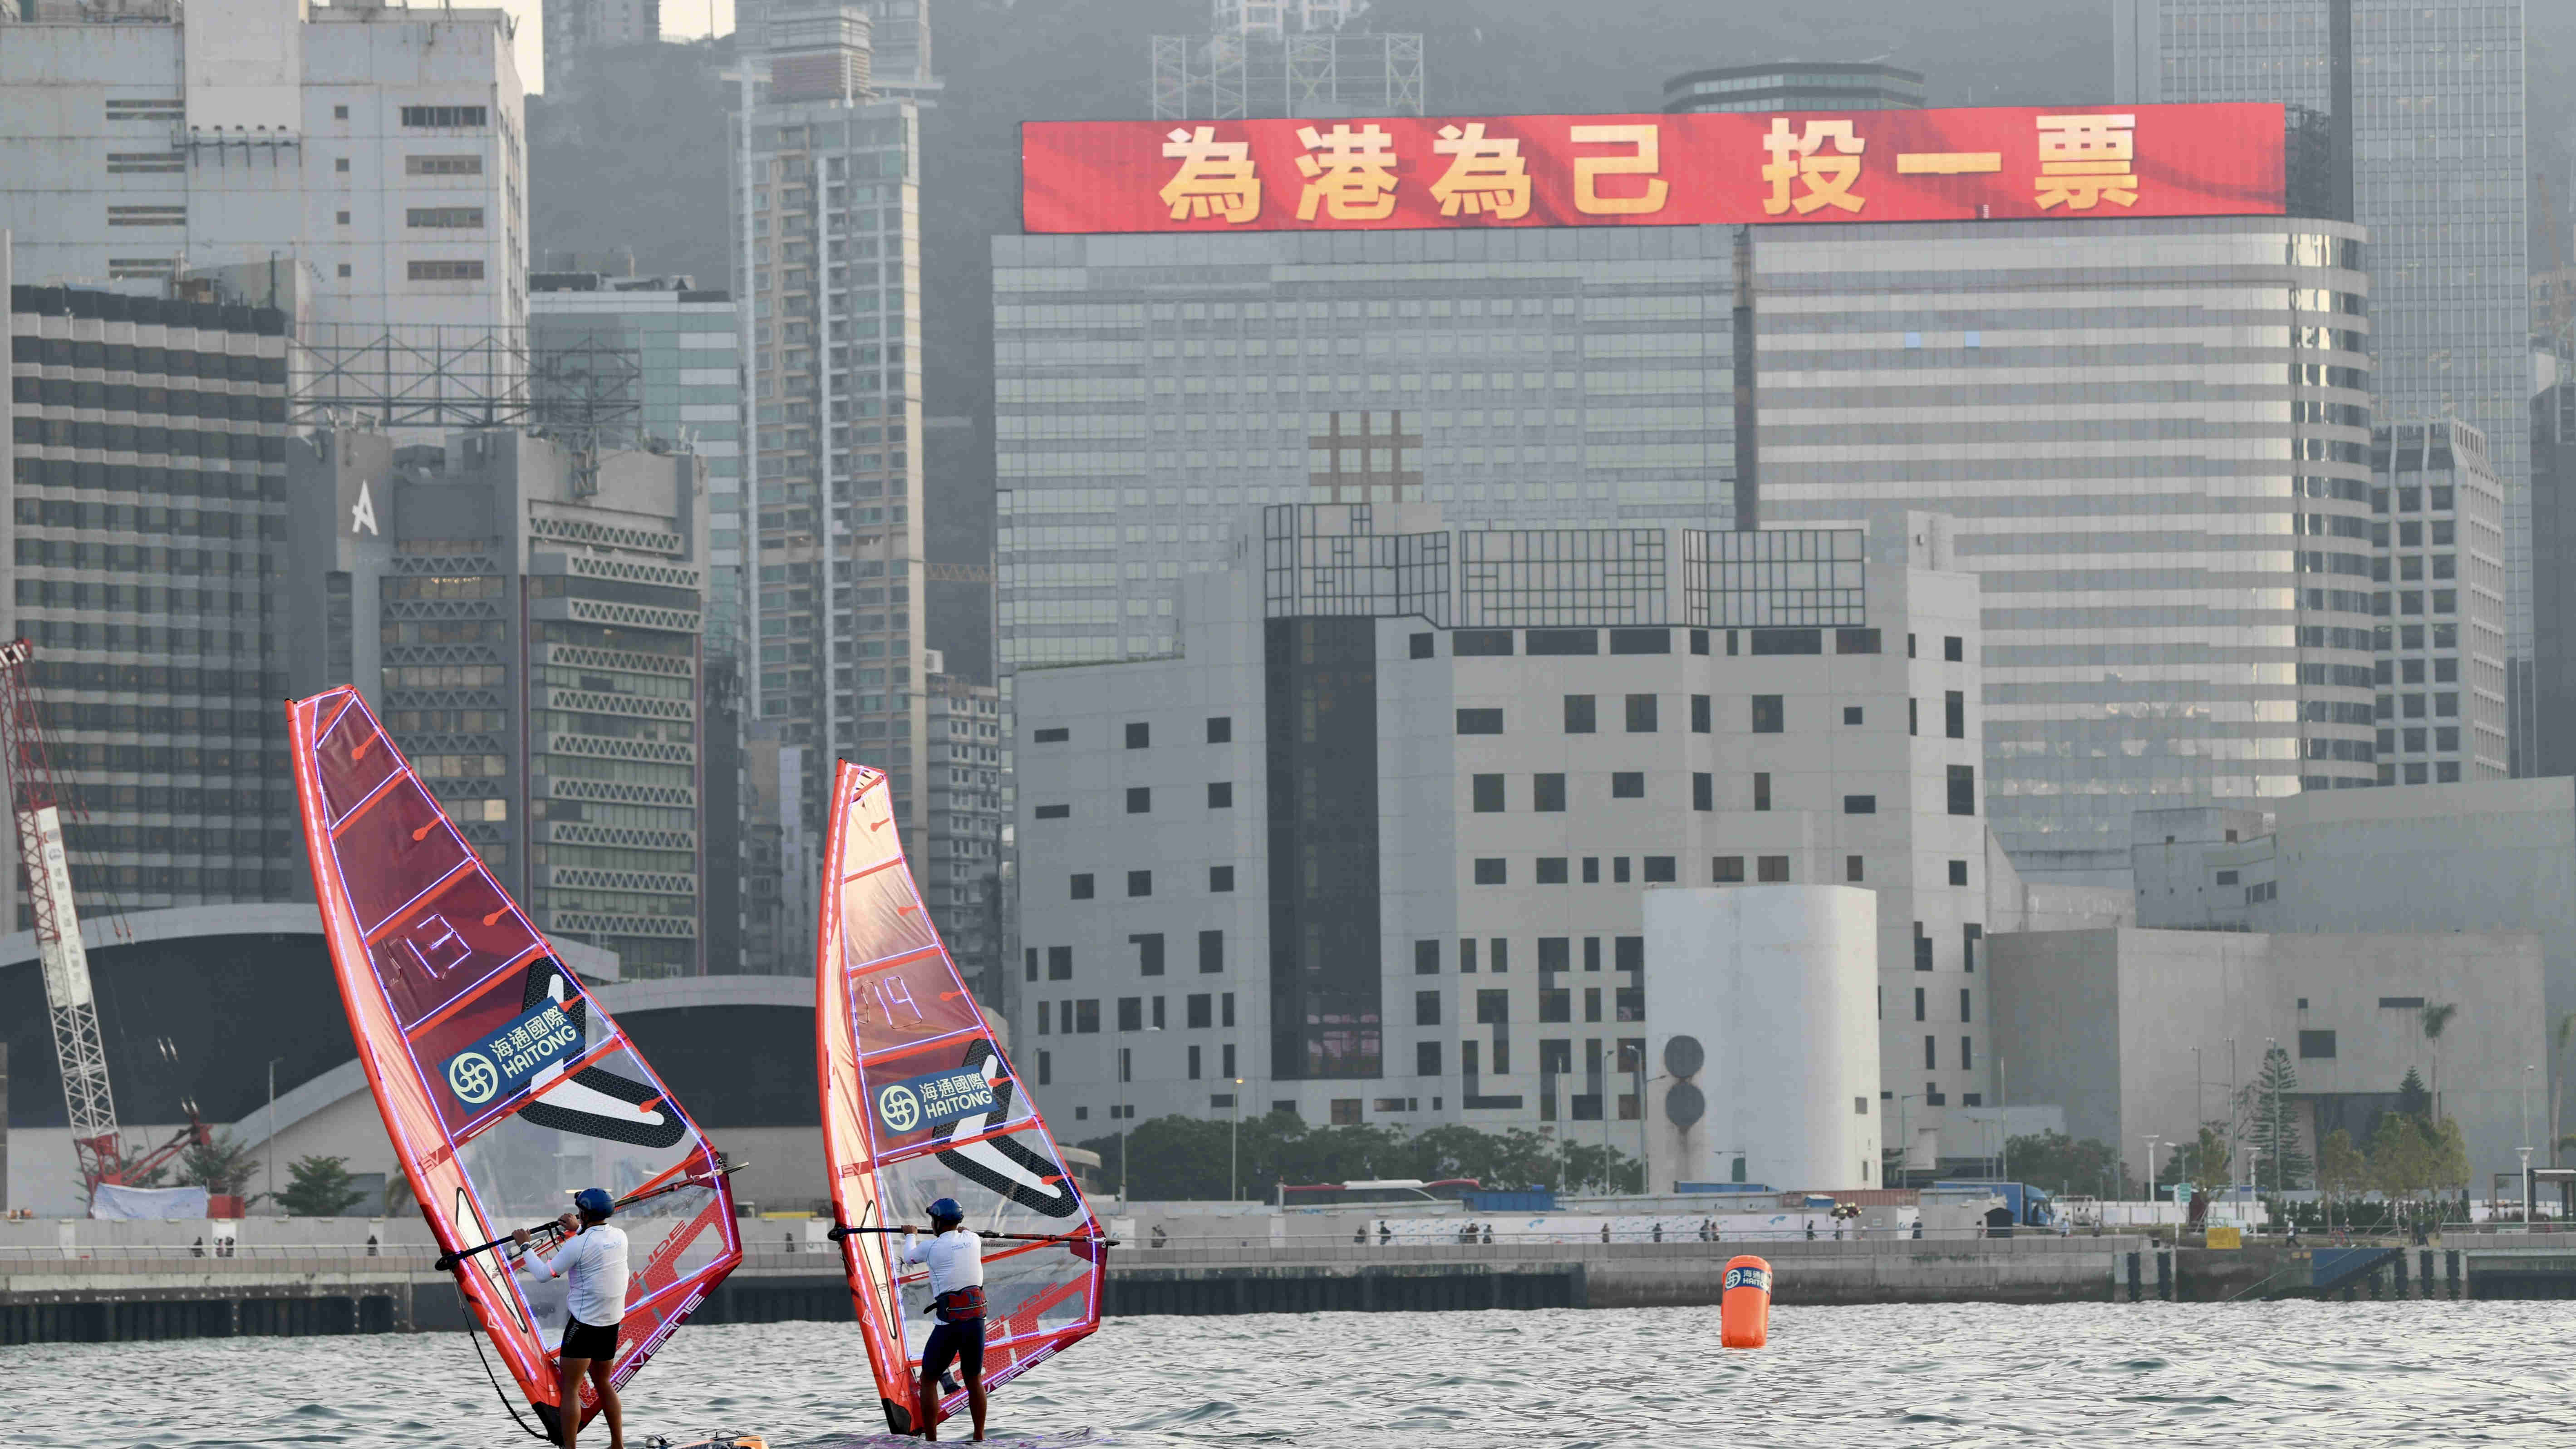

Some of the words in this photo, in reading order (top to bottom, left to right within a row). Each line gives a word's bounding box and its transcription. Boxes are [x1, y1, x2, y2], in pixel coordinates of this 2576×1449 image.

[1159, 123, 1668, 223] 為港為己
[1761, 114, 2139, 216] 投一票
[352, 479, 379, 536] A
[488, 1005, 567, 1062] 海通國際
[501, 1025, 577, 1079] HAITONG
[918, 1072, 987, 1103] 海通國際
[924, 1090, 993, 1119] HAITONG
[629, 1219, 687, 1286] LIDE
